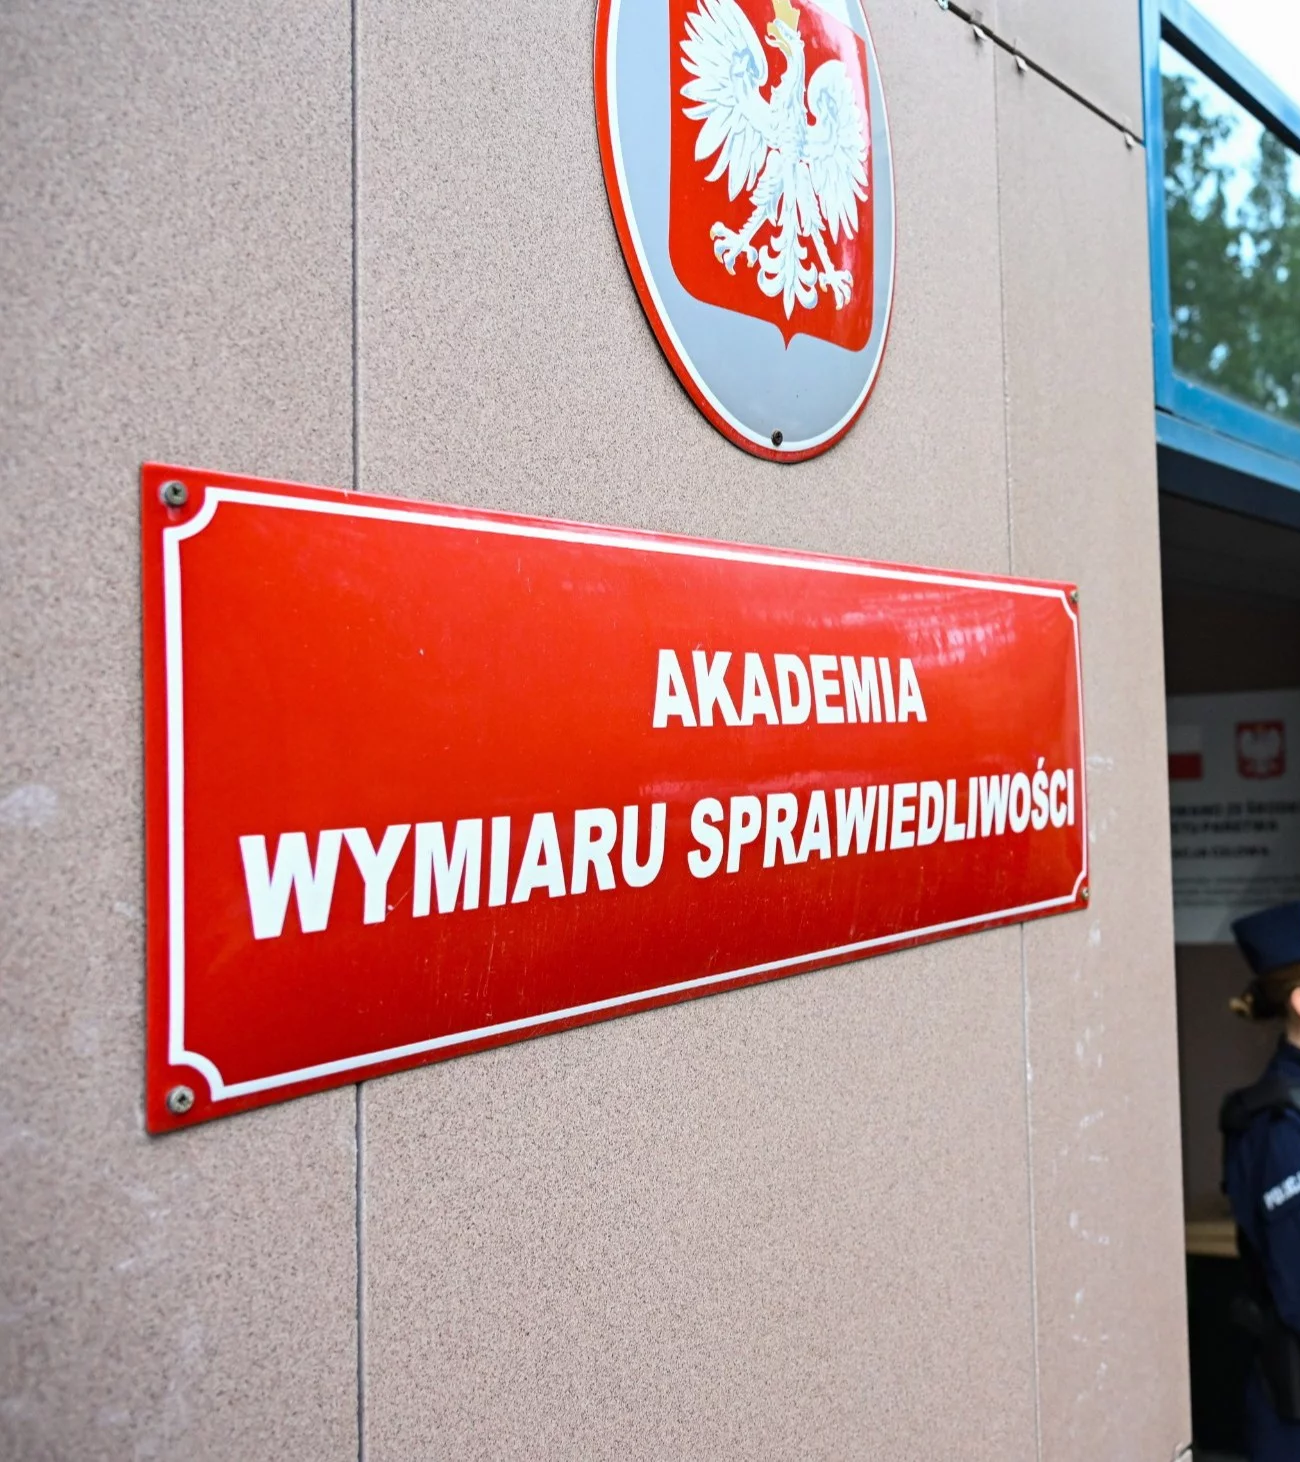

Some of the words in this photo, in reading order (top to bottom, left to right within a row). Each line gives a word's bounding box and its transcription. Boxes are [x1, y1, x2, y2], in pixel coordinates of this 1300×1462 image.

[652, 648, 927, 727] AKADEMIA
[239, 802, 667, 939] WYMIARU
[687, 757, 1075, 878] SPRAWIEDLIWOŚCI
